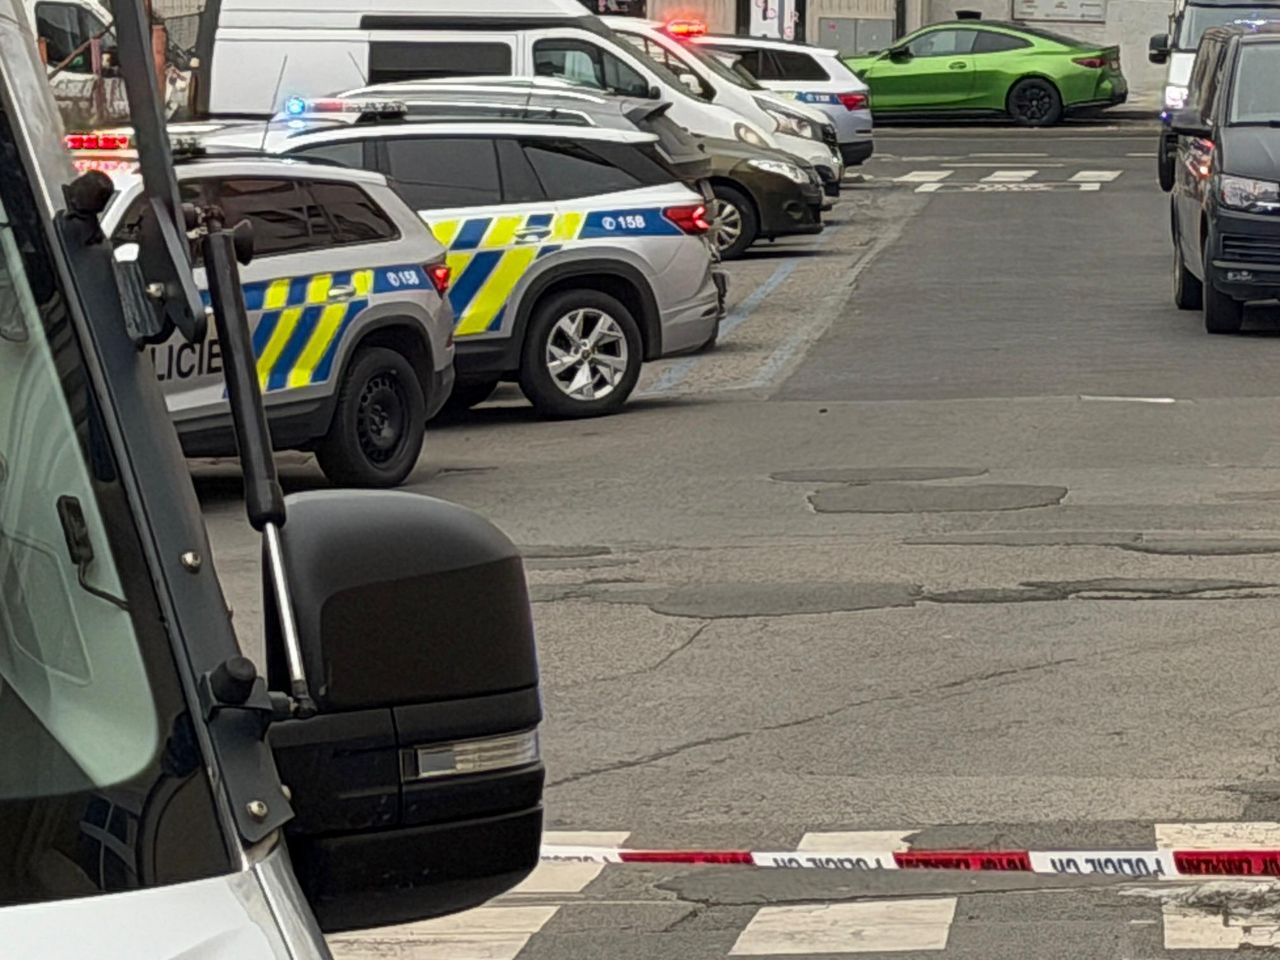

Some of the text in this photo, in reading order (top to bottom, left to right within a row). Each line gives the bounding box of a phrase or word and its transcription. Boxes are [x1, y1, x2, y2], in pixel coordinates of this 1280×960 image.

[618, 215, 646, 229] 158
[398, 270, 419, 285] 158
[151, 340, 223, 381] LICIE
